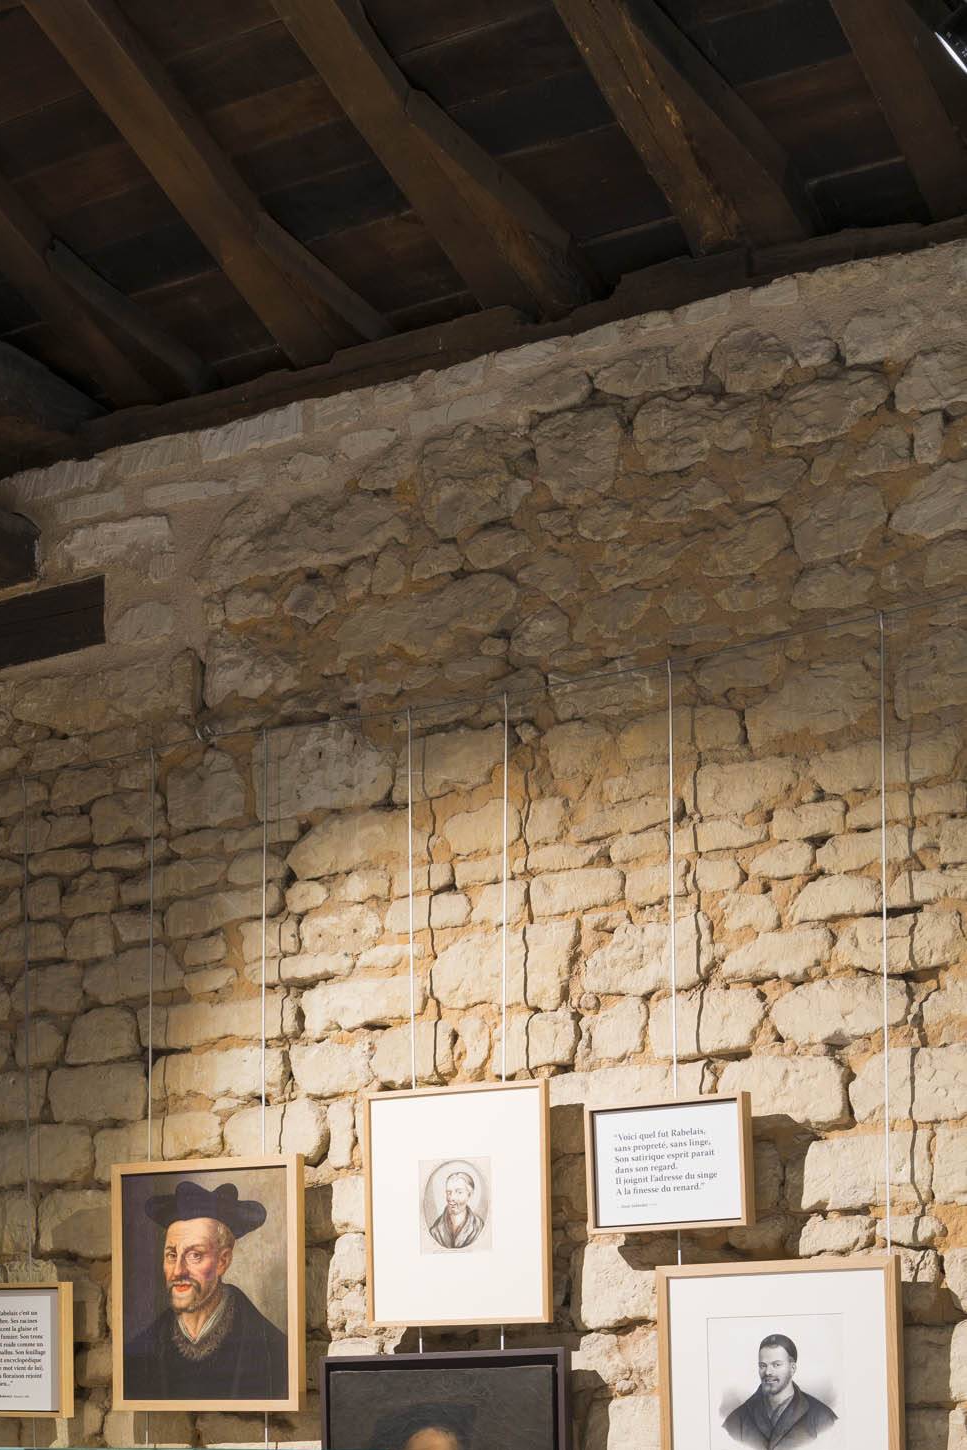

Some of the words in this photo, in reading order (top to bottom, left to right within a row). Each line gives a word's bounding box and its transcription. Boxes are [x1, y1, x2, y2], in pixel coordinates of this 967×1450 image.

[667, 1151, 689, 1160] esprit
[615, 1166, 633, 1174] dans
[685, 1172, 695, 1180] du
[697, 1172, 717, 1180] singe
